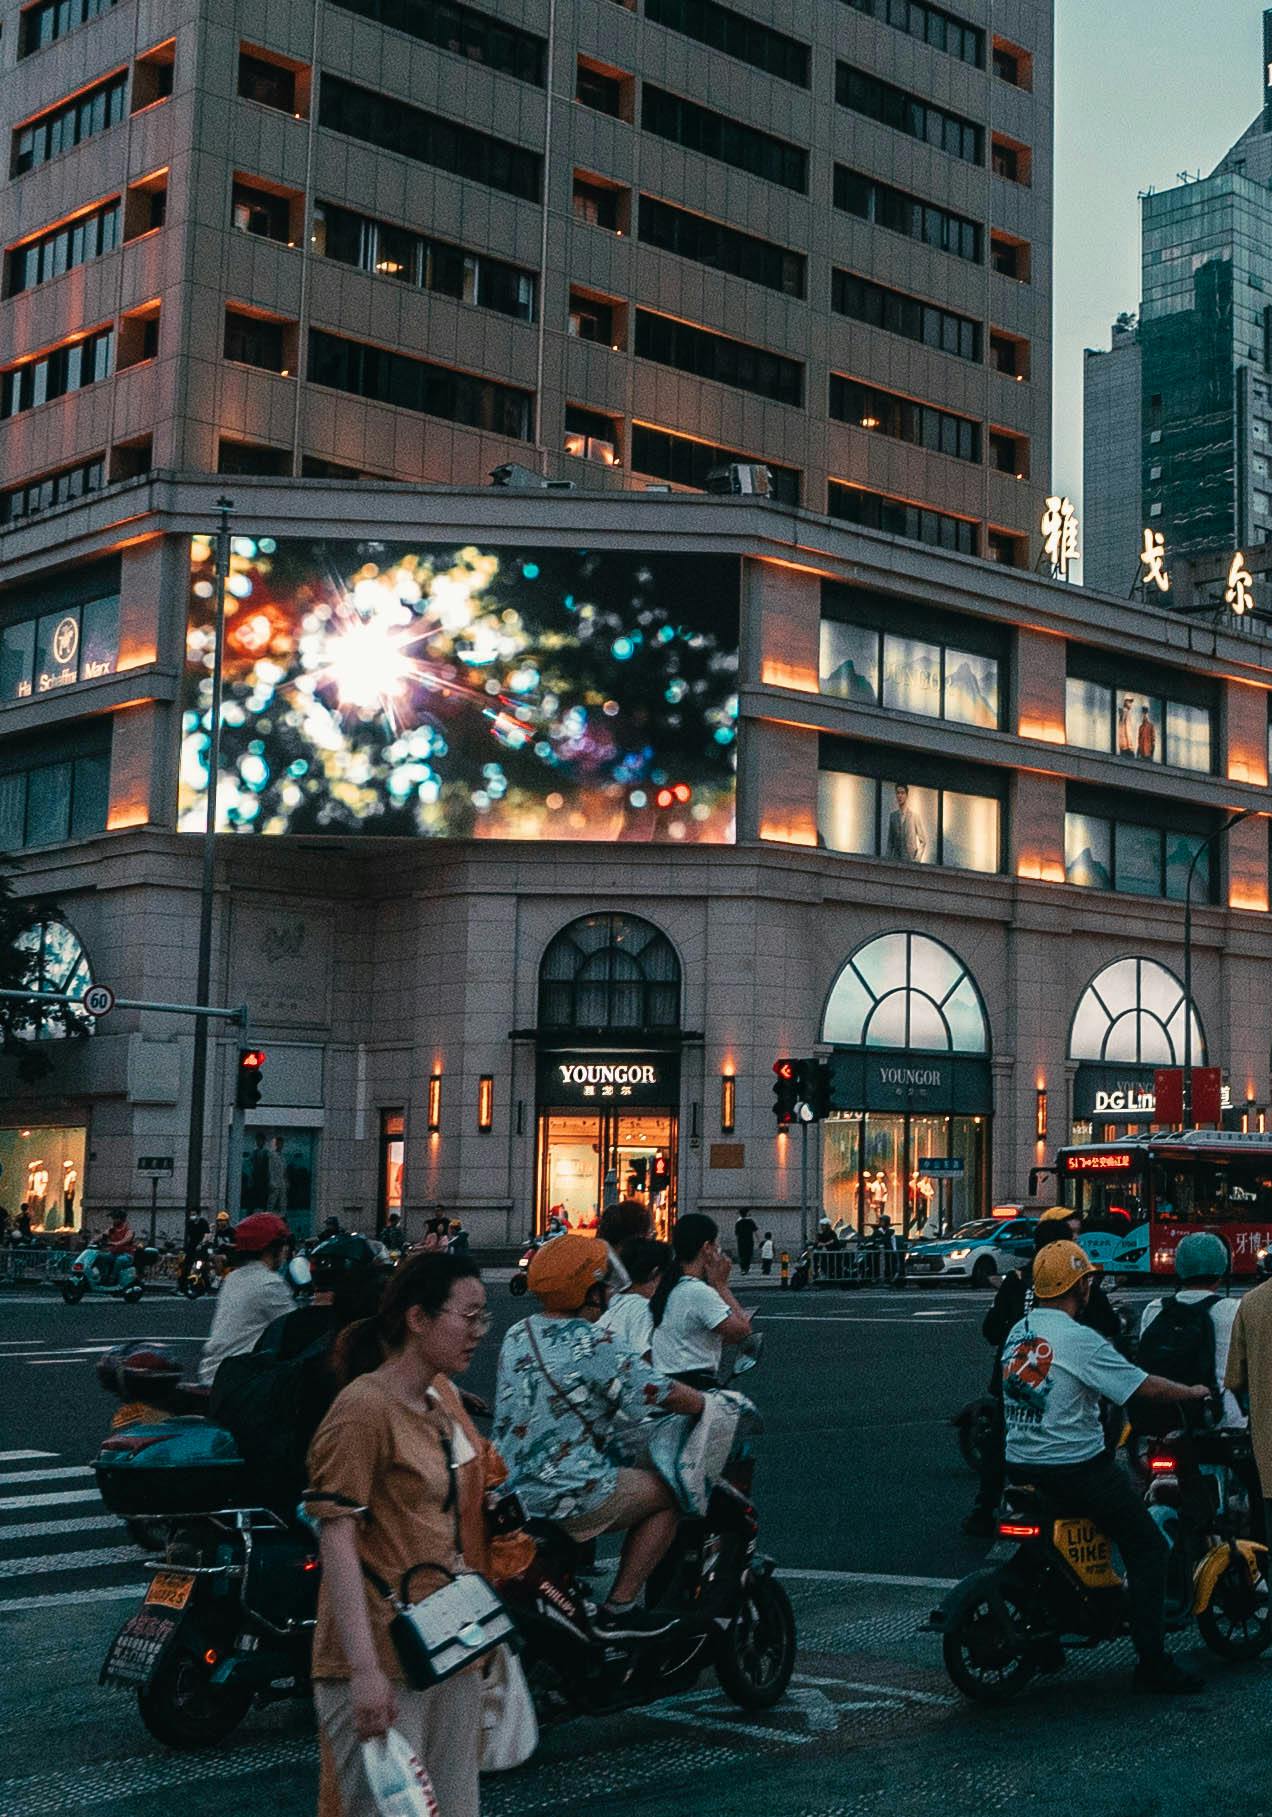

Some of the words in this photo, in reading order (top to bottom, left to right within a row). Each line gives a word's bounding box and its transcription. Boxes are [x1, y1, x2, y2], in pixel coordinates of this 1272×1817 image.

[1041, 496, 1254, 615] 雅戈尔
[84, 661, 110, 680] Marx
[90, 992, 108, 1009] 60
[559, 1065, 657, 1084] YOUNGOR
[880, 1067, 941, 1086] YOUNGOR
[1067, 1526, 1094, 1546] LIU
[1068, 1541, 1107, 1563] BIKE
